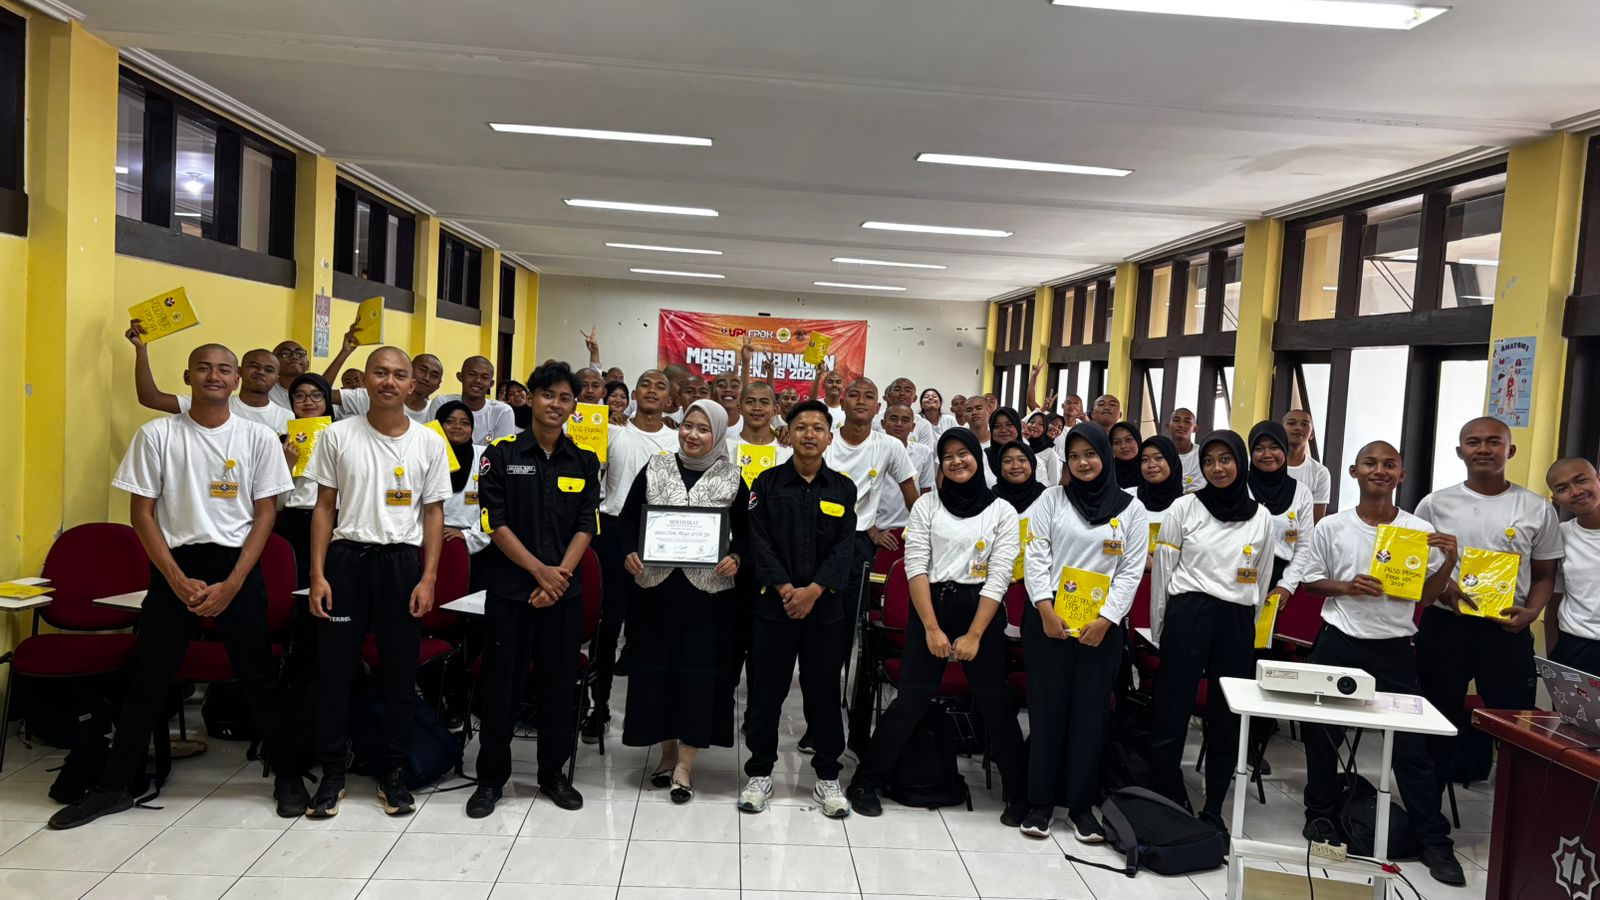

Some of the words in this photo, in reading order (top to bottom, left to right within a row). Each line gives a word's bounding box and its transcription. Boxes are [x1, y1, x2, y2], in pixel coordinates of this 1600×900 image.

[1501, 342, 1530, 352] ANATOMI
[686, 347, 736, 365] MASA
[740, 351, 835, 371] IMBINGN
[1068, 611, 1087, 621] 2025
